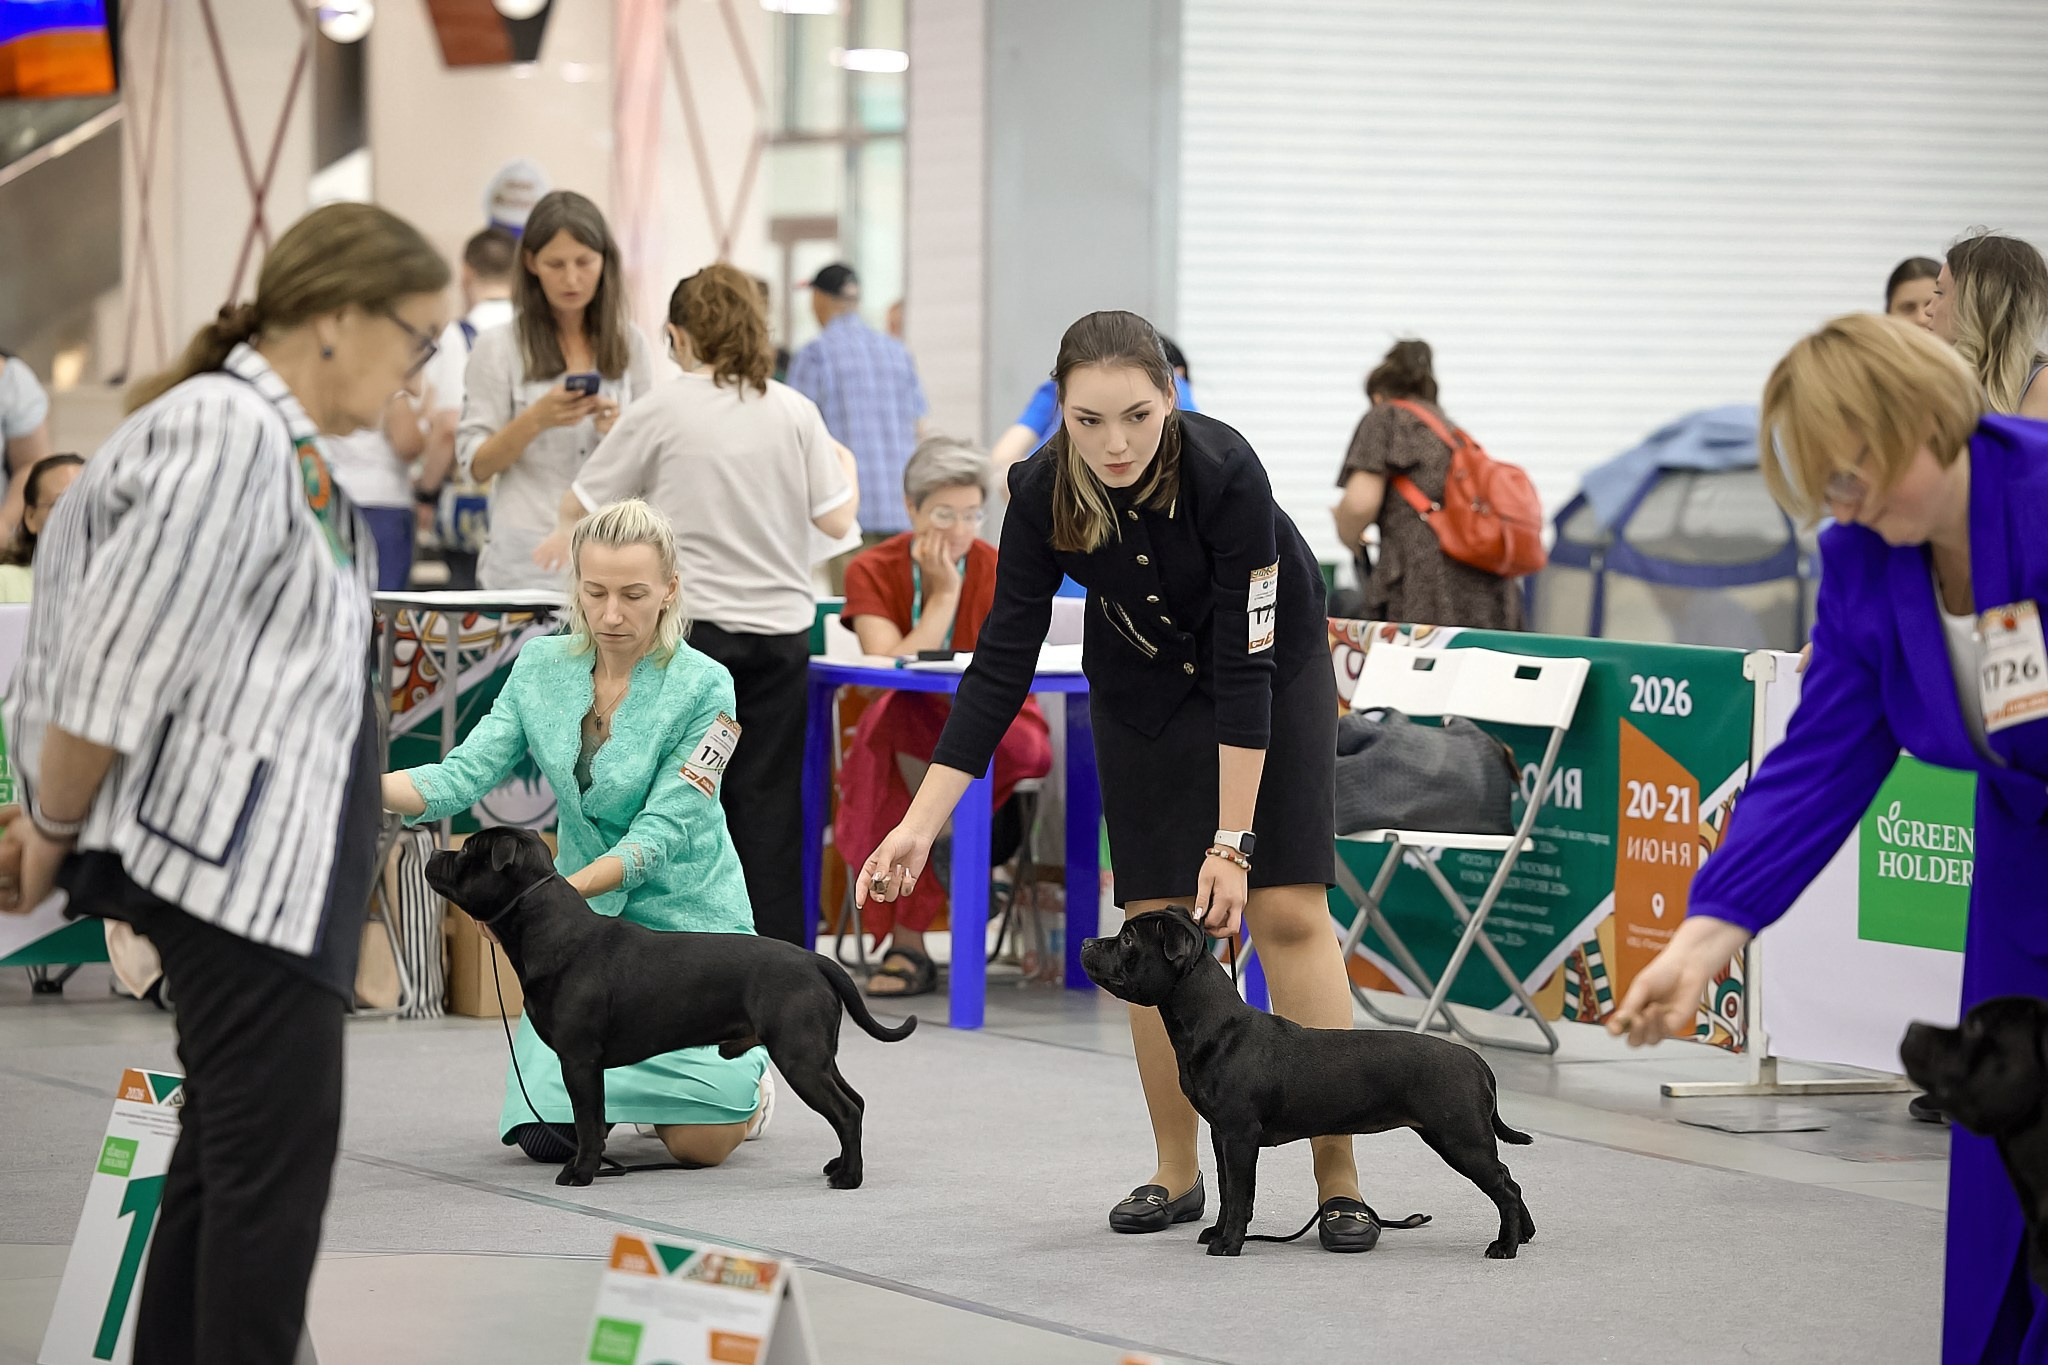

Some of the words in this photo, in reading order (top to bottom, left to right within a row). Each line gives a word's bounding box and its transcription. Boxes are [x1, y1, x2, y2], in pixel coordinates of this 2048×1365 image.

[1629, 674, 1693, 717] 2026
[1626, 780, 1690, 825] 20-21
[1626, 836, 1692, 867] ИЮНЯ
[1893, 819, 1974, 854] GREEN
[1877, 850, 1974, 887] HOLDER
[92, 1174, 167, 1361] 1
